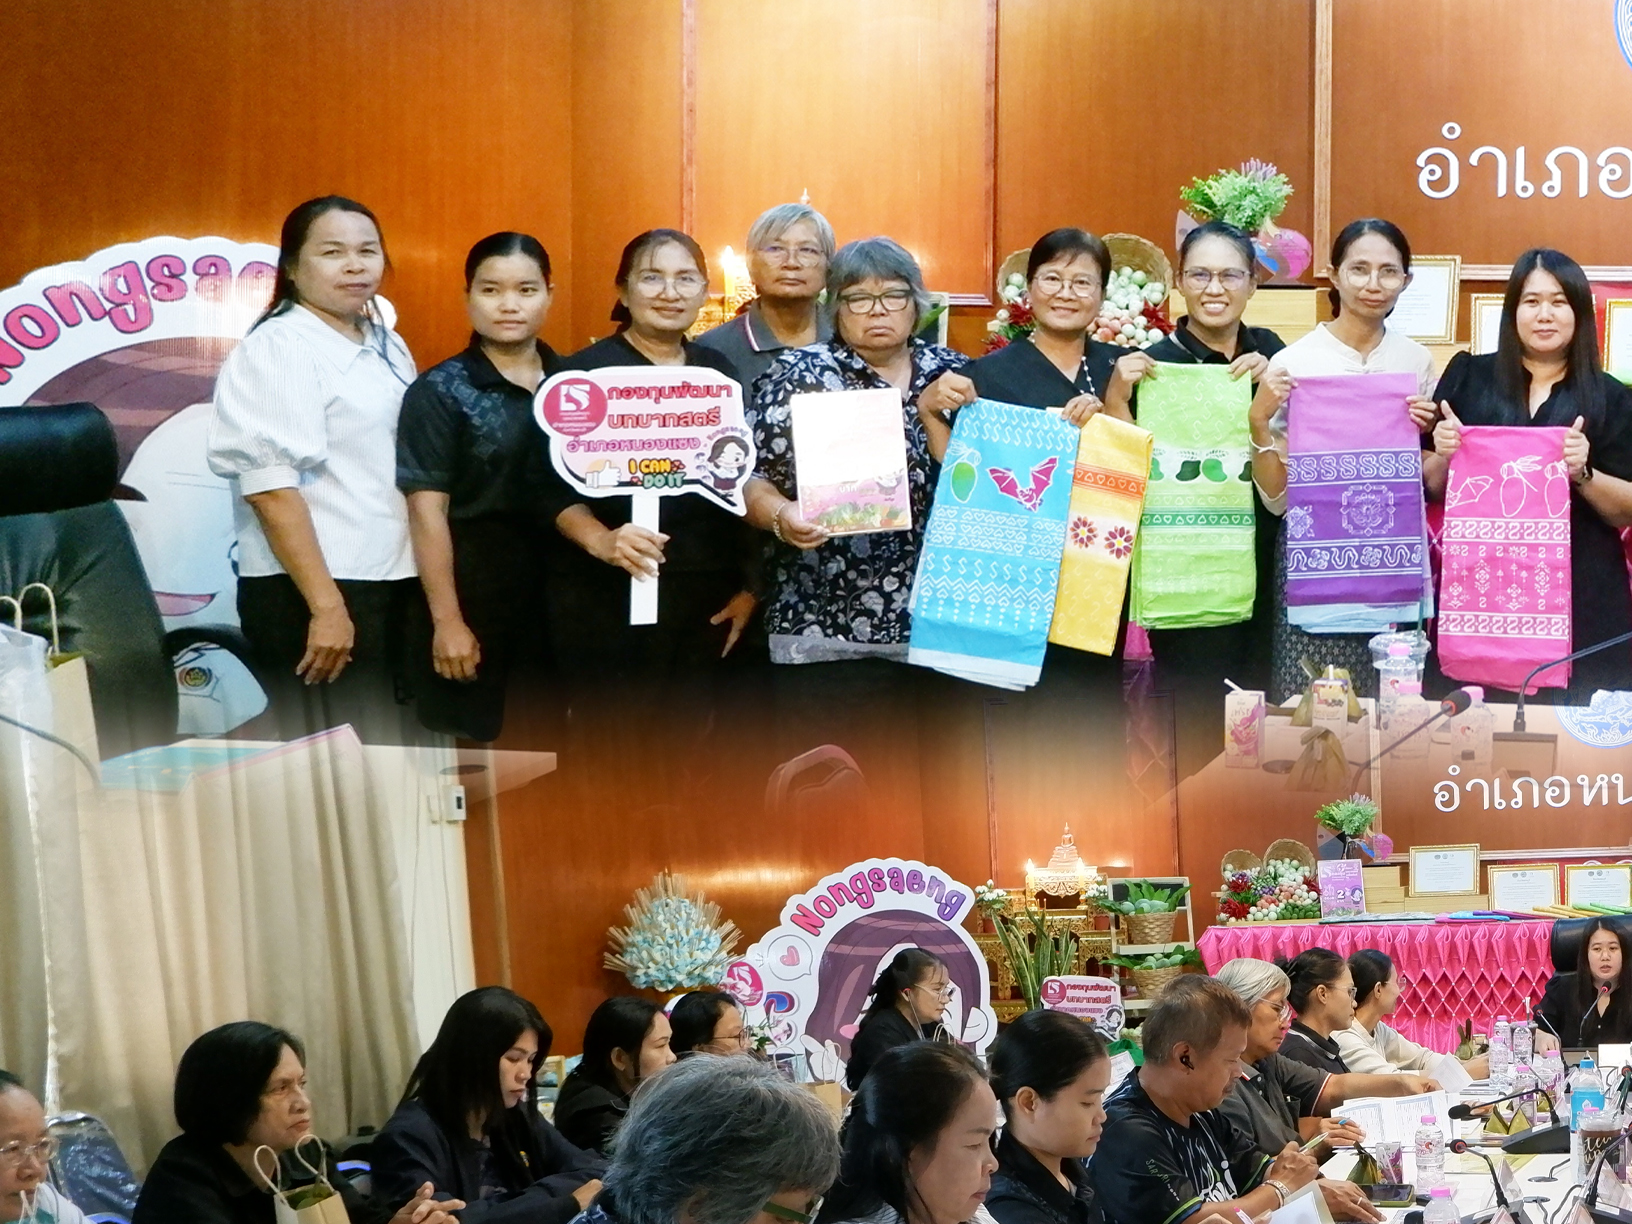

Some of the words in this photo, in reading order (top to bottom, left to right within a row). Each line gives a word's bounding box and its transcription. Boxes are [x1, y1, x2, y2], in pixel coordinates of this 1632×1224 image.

[606, 380, 733, 404] กองทุนพัฒนา
[607, 406, 722, 429] บทบาทสตรี
[566, 435, 702, 453] อำเภอหนองแซง
[628, 458, 638, 474] I
[638, 457, 672, 474] CAN
[643, 473, 667, 489] DO
[668, 472, 686, 488] IT
[790, 866, 967, 937] Nongsaeng
